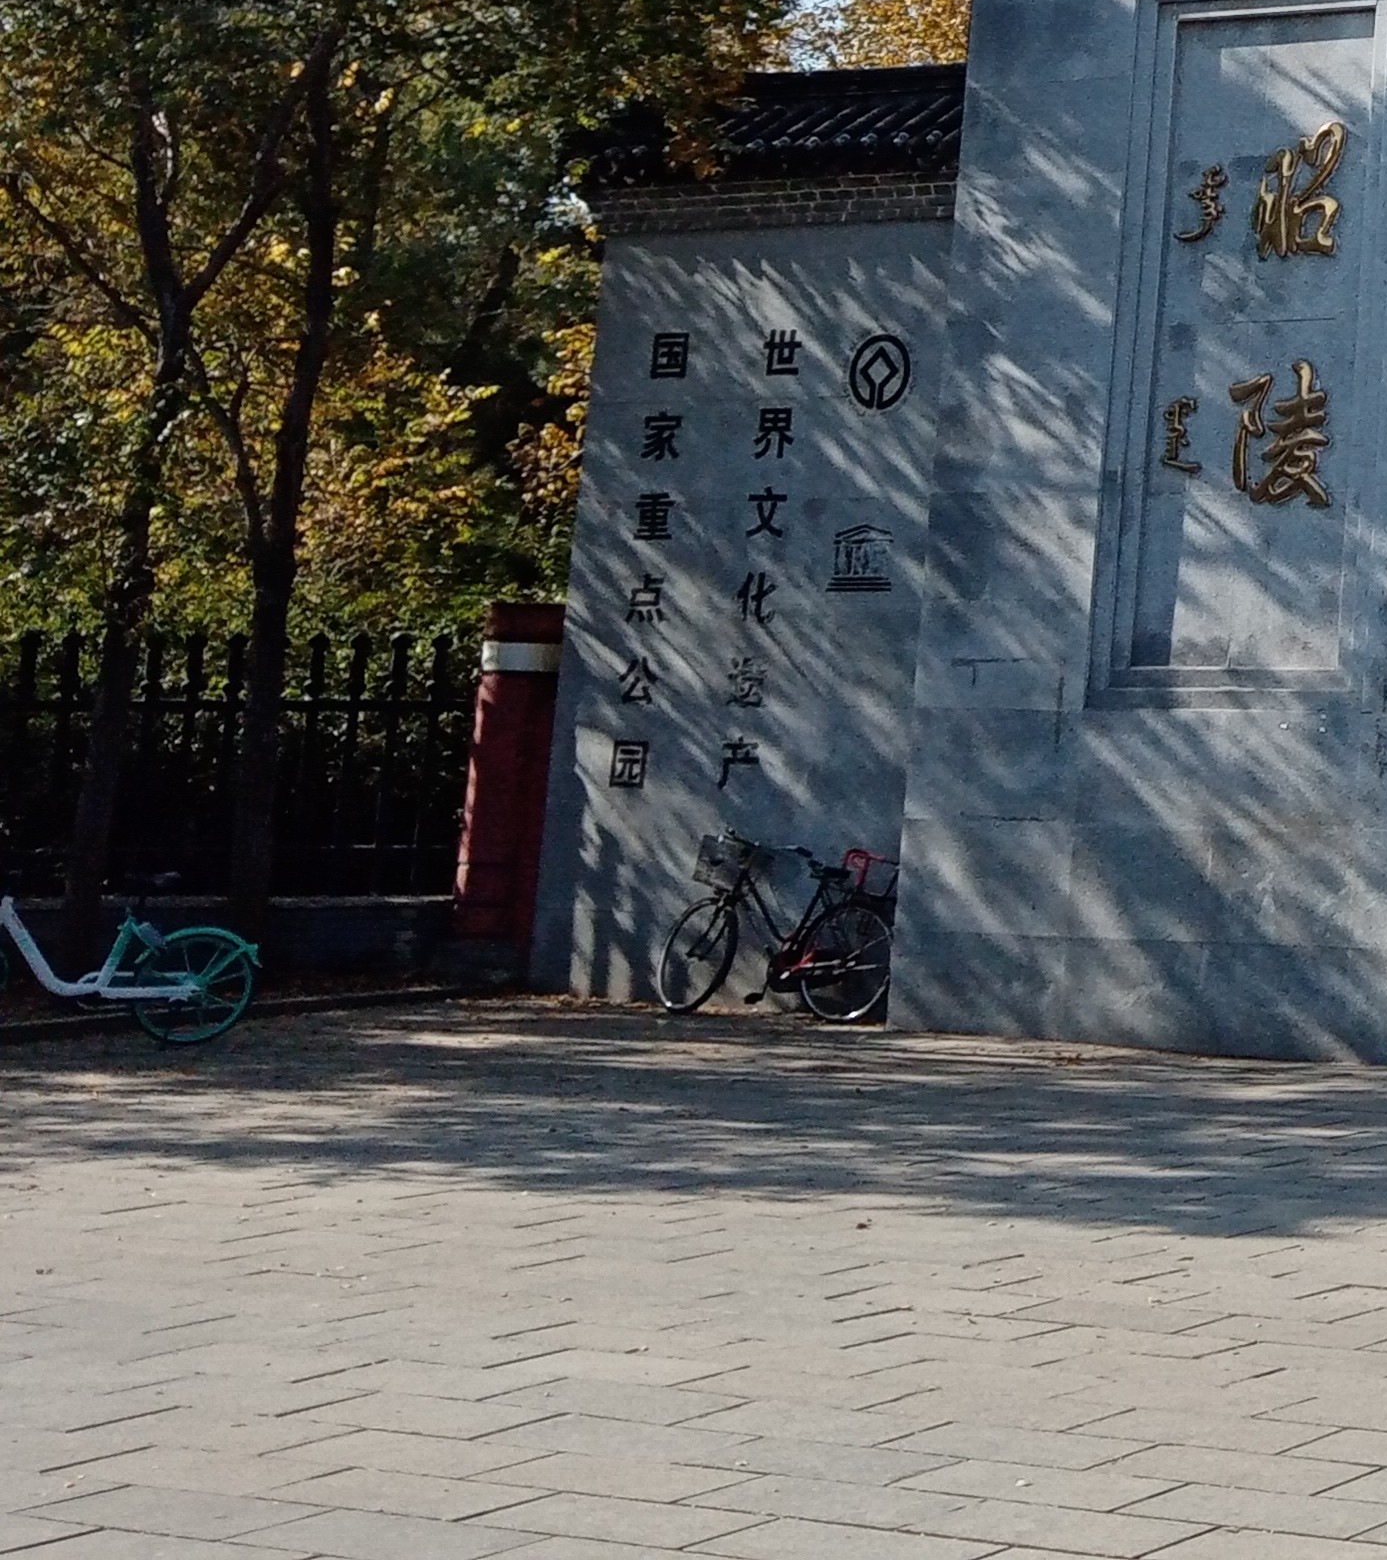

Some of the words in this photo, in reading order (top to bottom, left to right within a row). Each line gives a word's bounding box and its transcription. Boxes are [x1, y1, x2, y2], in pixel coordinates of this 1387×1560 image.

[1228, 120, 1348, 509] 昭陵
[607, 331, 690, 789] 国家重点公园
[718, 328, 801, 790] 世界文化遗产
